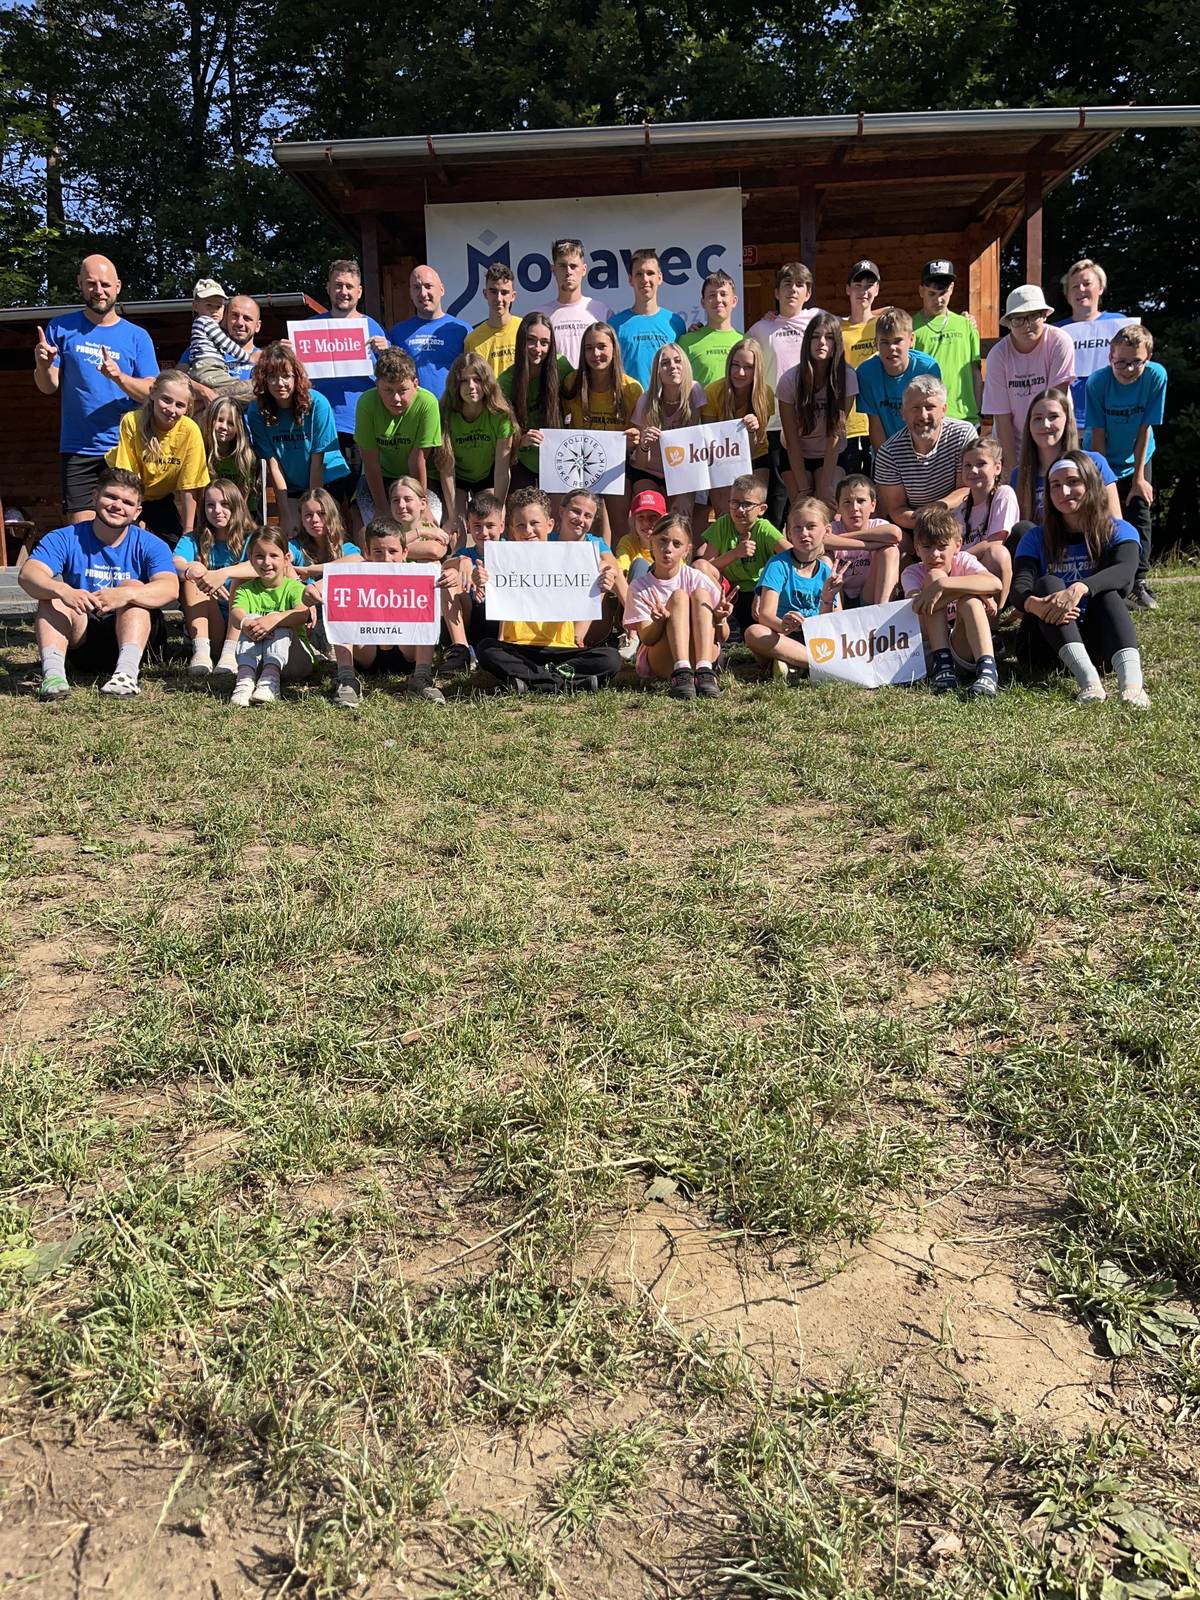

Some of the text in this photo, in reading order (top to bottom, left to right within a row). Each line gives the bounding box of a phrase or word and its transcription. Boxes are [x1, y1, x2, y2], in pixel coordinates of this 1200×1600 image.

[299, 338, 361, 354] T Mobile
[563, 436, 599, 449] POLICIE
[689, 437, 740, 467] kofola
[495, 571, 591, 588] DĚKUJEME
[333, 588, 428, 609] T Mobile
[360, 624, 403, 635] BRUNTÁL
[841, 625, 909, 663] kofola
